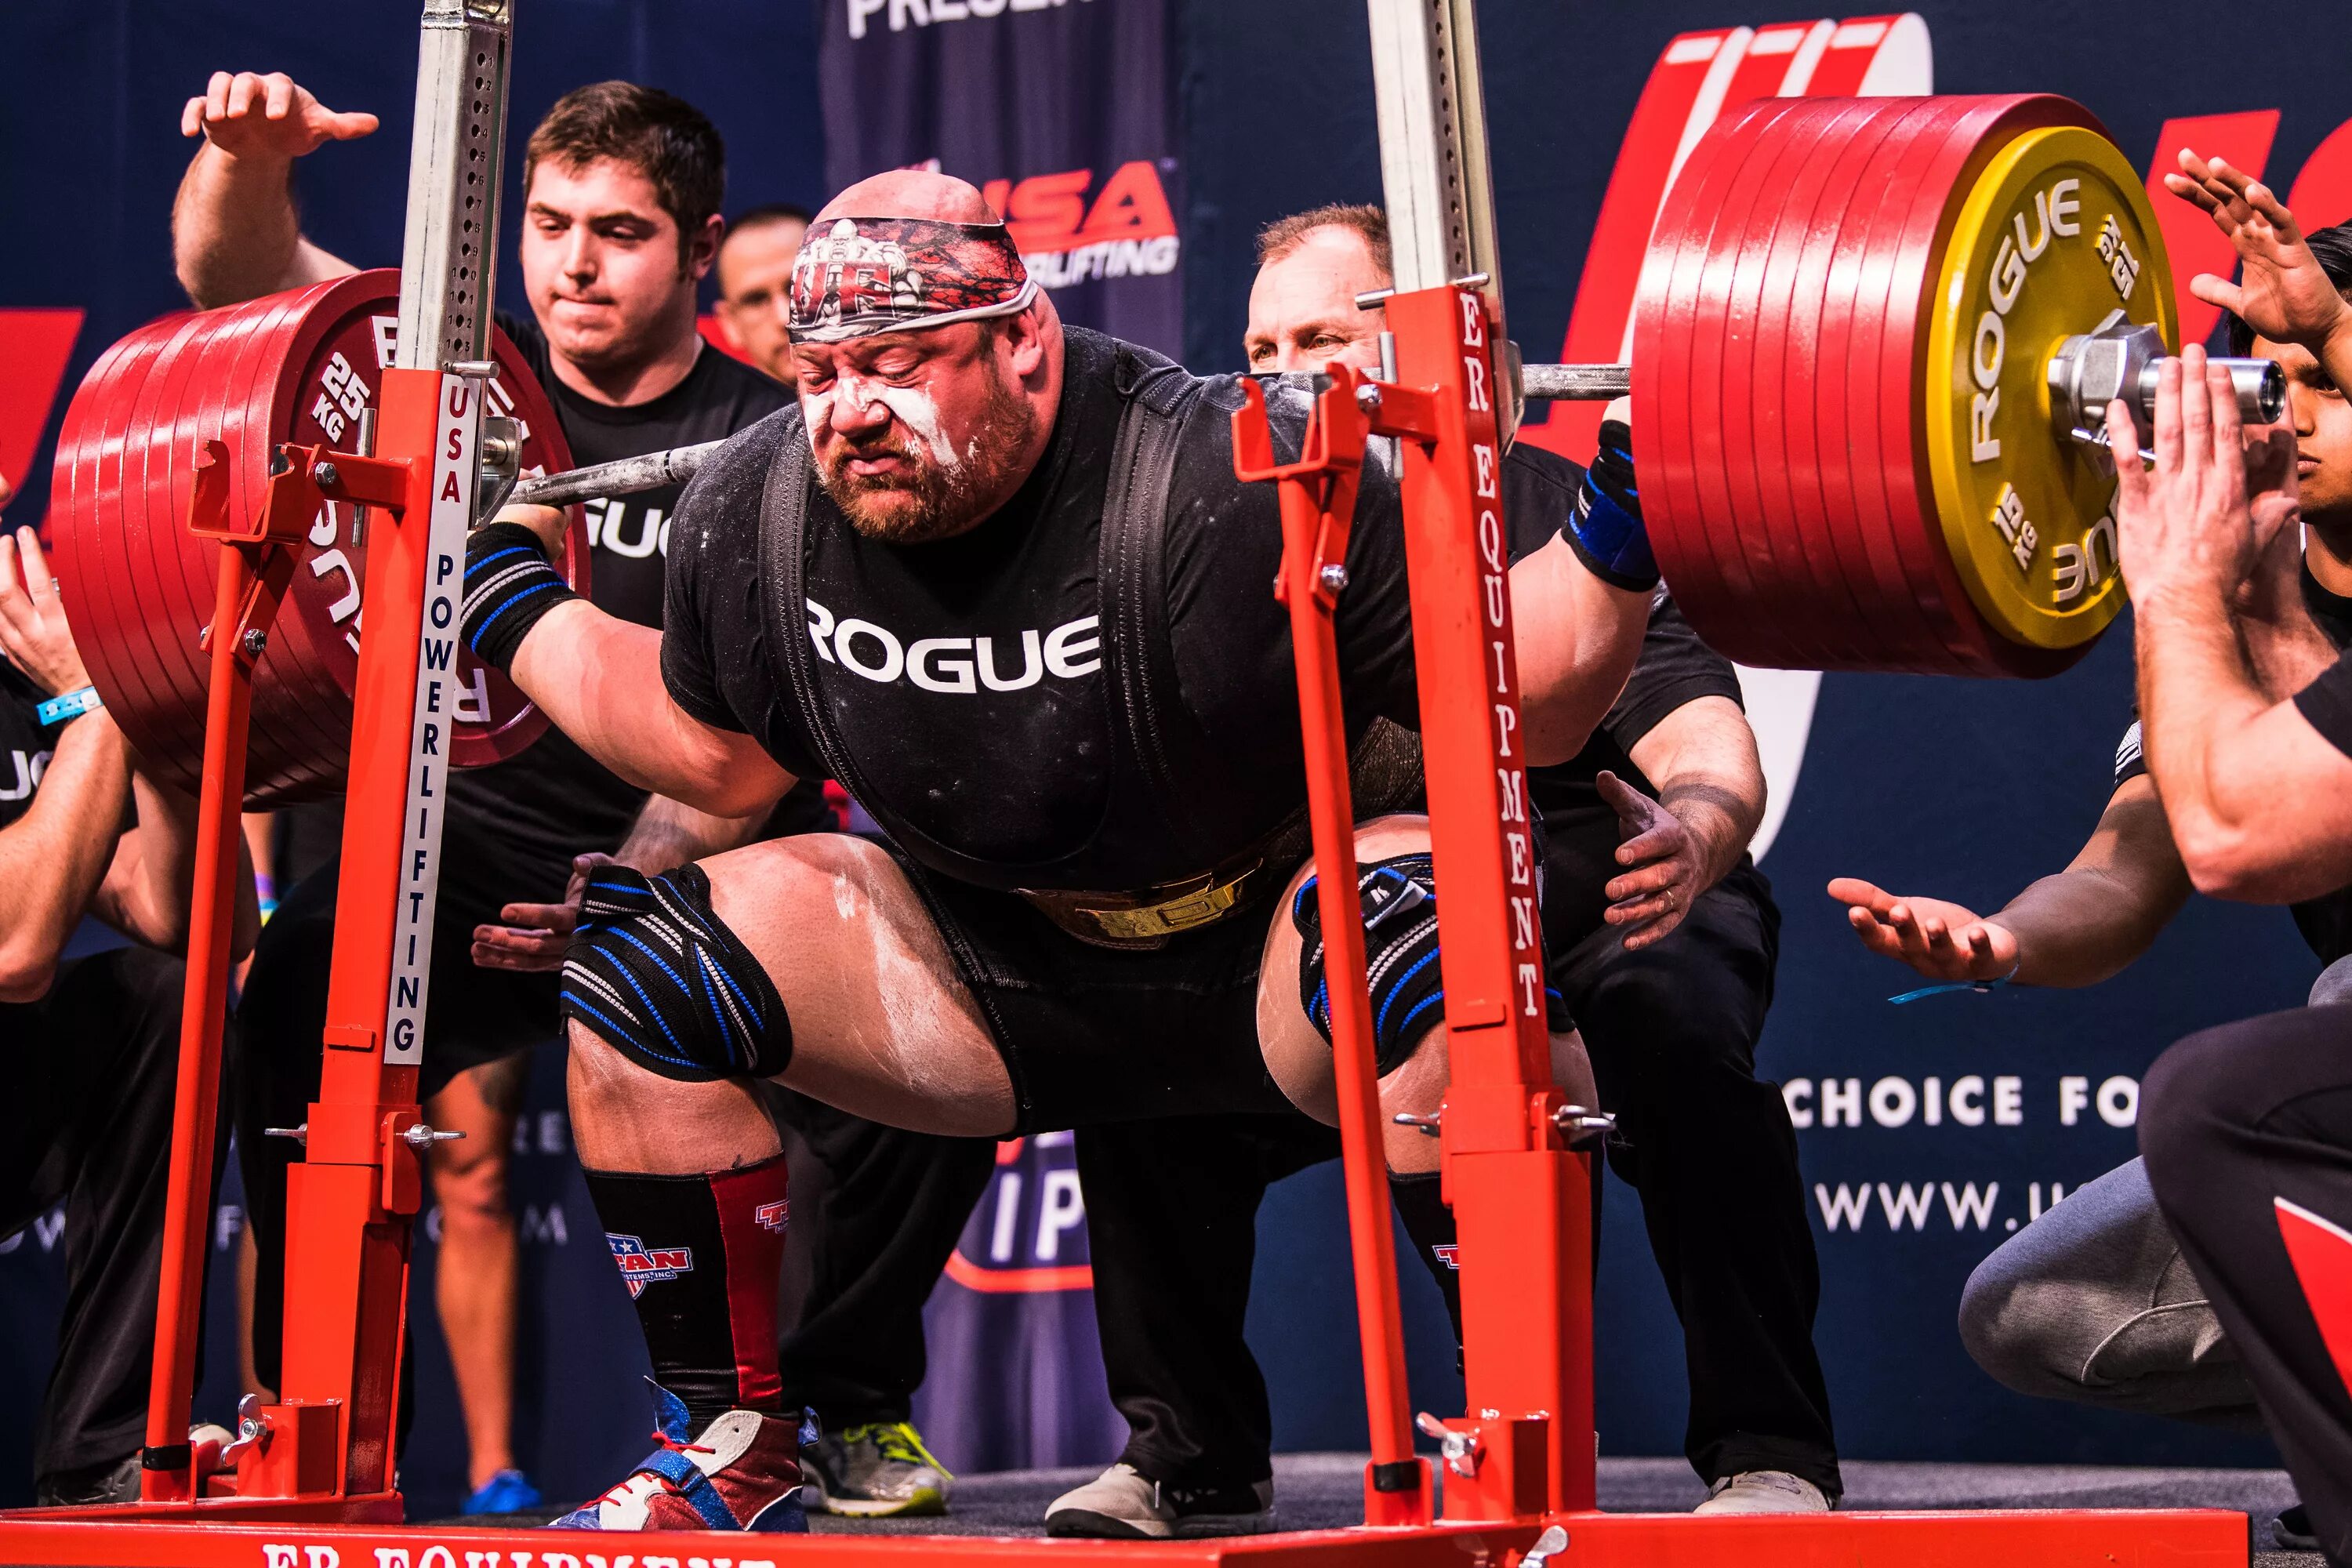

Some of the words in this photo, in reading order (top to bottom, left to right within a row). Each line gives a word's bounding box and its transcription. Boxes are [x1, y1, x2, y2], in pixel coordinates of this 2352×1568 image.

[484, 104, 490, 114] 3
[486, 80, 492, 92] 2
[480, 151, 486, 162] 5
[482, 129, 488, 139] 4
[477, 200, 482, 210] 7
[478, 176, 485, 186] 6
[473, 246, 478, 257] 9
[474, 223, 481, 234] 8
[2095, 213, 2122, 263] KG
[2111, 241, 2140, 301] 15
[1971, 178, 2081, 463] ROGUE
[319, 351, 371, 422] 25
[310, 392, 345, 444] KG
[441, 384, 470, 503] USA
[1992, 481, 2024, 543] 15
[2013, 520, 2038, 571] KG
[806, 597, 1102, 694] ROGUE
[1459, 292, 1489, 412] ER
[1474, 443, 1538, 1016] EQUIPMENT
[394, 554, 454, 1051] POWERLIFTING
[1781, 1076, 2024, 1128] CHOICE
